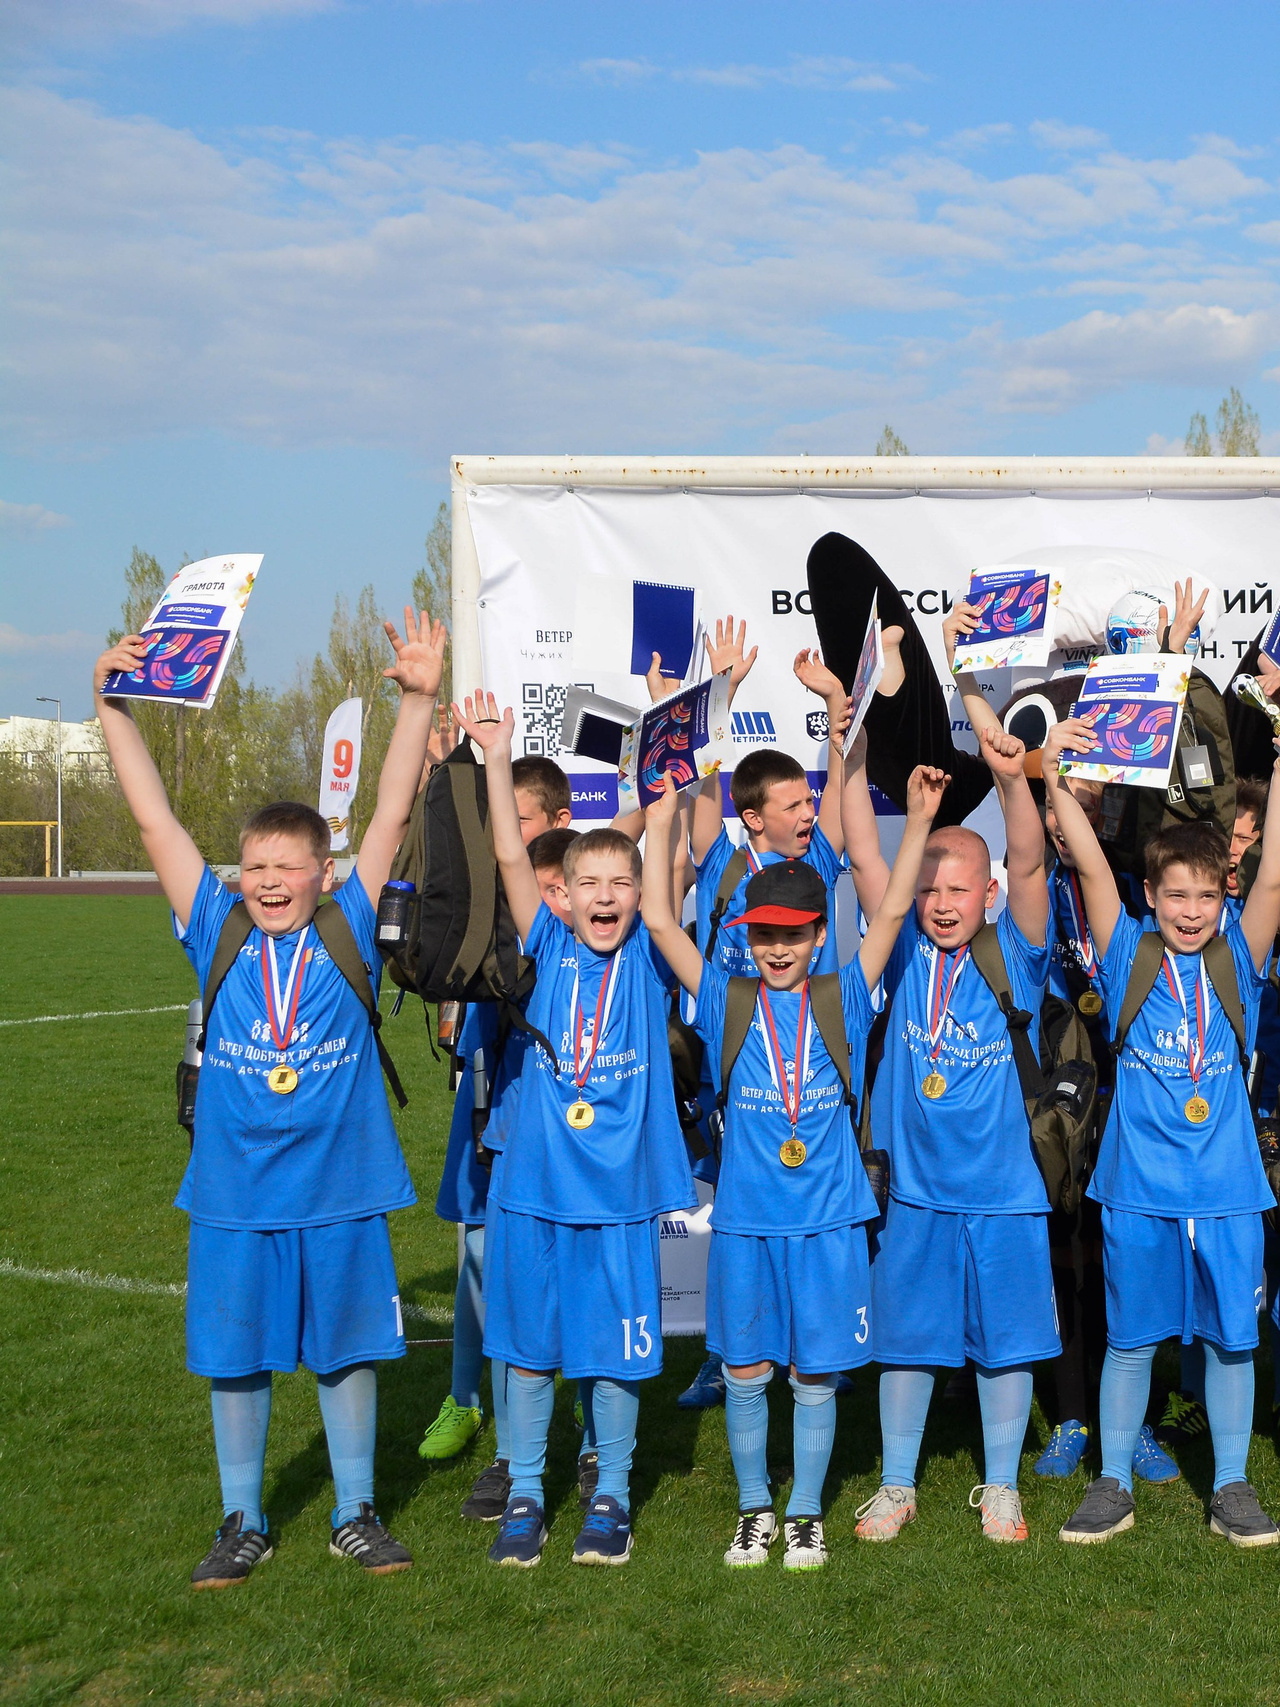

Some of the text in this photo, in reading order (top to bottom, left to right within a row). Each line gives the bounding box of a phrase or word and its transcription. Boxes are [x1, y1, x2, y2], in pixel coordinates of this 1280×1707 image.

[181, 582, 225, 593] ГРАМОТА
[520, 647, 563, 660] Чужих
[332, 738, 354, 779] 9
[330, 781, 350, 793] МАЯ
[962, 1060, 977, 1069] не
[238, 1066, 269, 1077] дете
[591, 1075, 607, 1084] не
[741, 1085, 764, 1099] ВЕТЕР
[760, 1106, 787, 1114] дете
[800, 1105, 814, 1114] не
[853, 1305, 870, 1345] 3
[621, 1314, 653, 1361] 13
